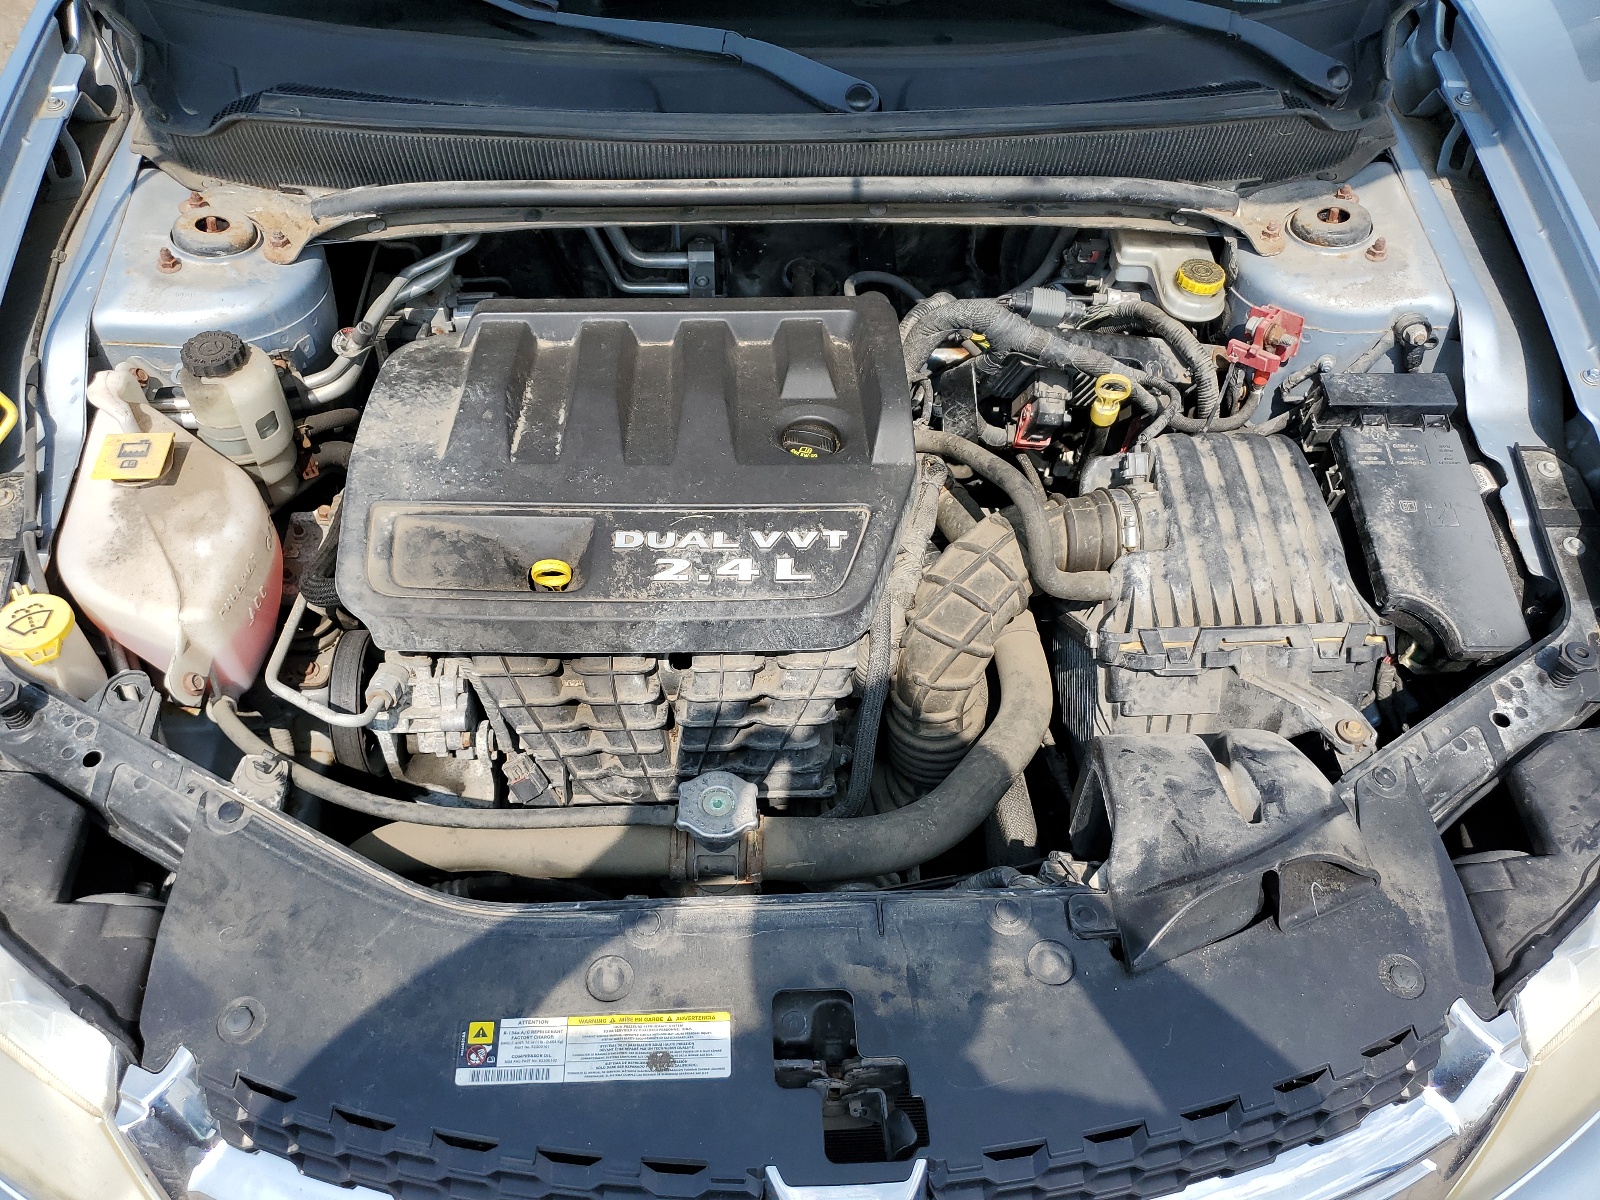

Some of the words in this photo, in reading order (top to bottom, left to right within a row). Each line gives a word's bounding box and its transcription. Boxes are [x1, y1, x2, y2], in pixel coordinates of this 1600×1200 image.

[613, 530, 740, 549] DUAL
[749, 530, 848, 549] VVT
[652, 558, 760, 582] 2.4
[775, 558, 812, 582] L
